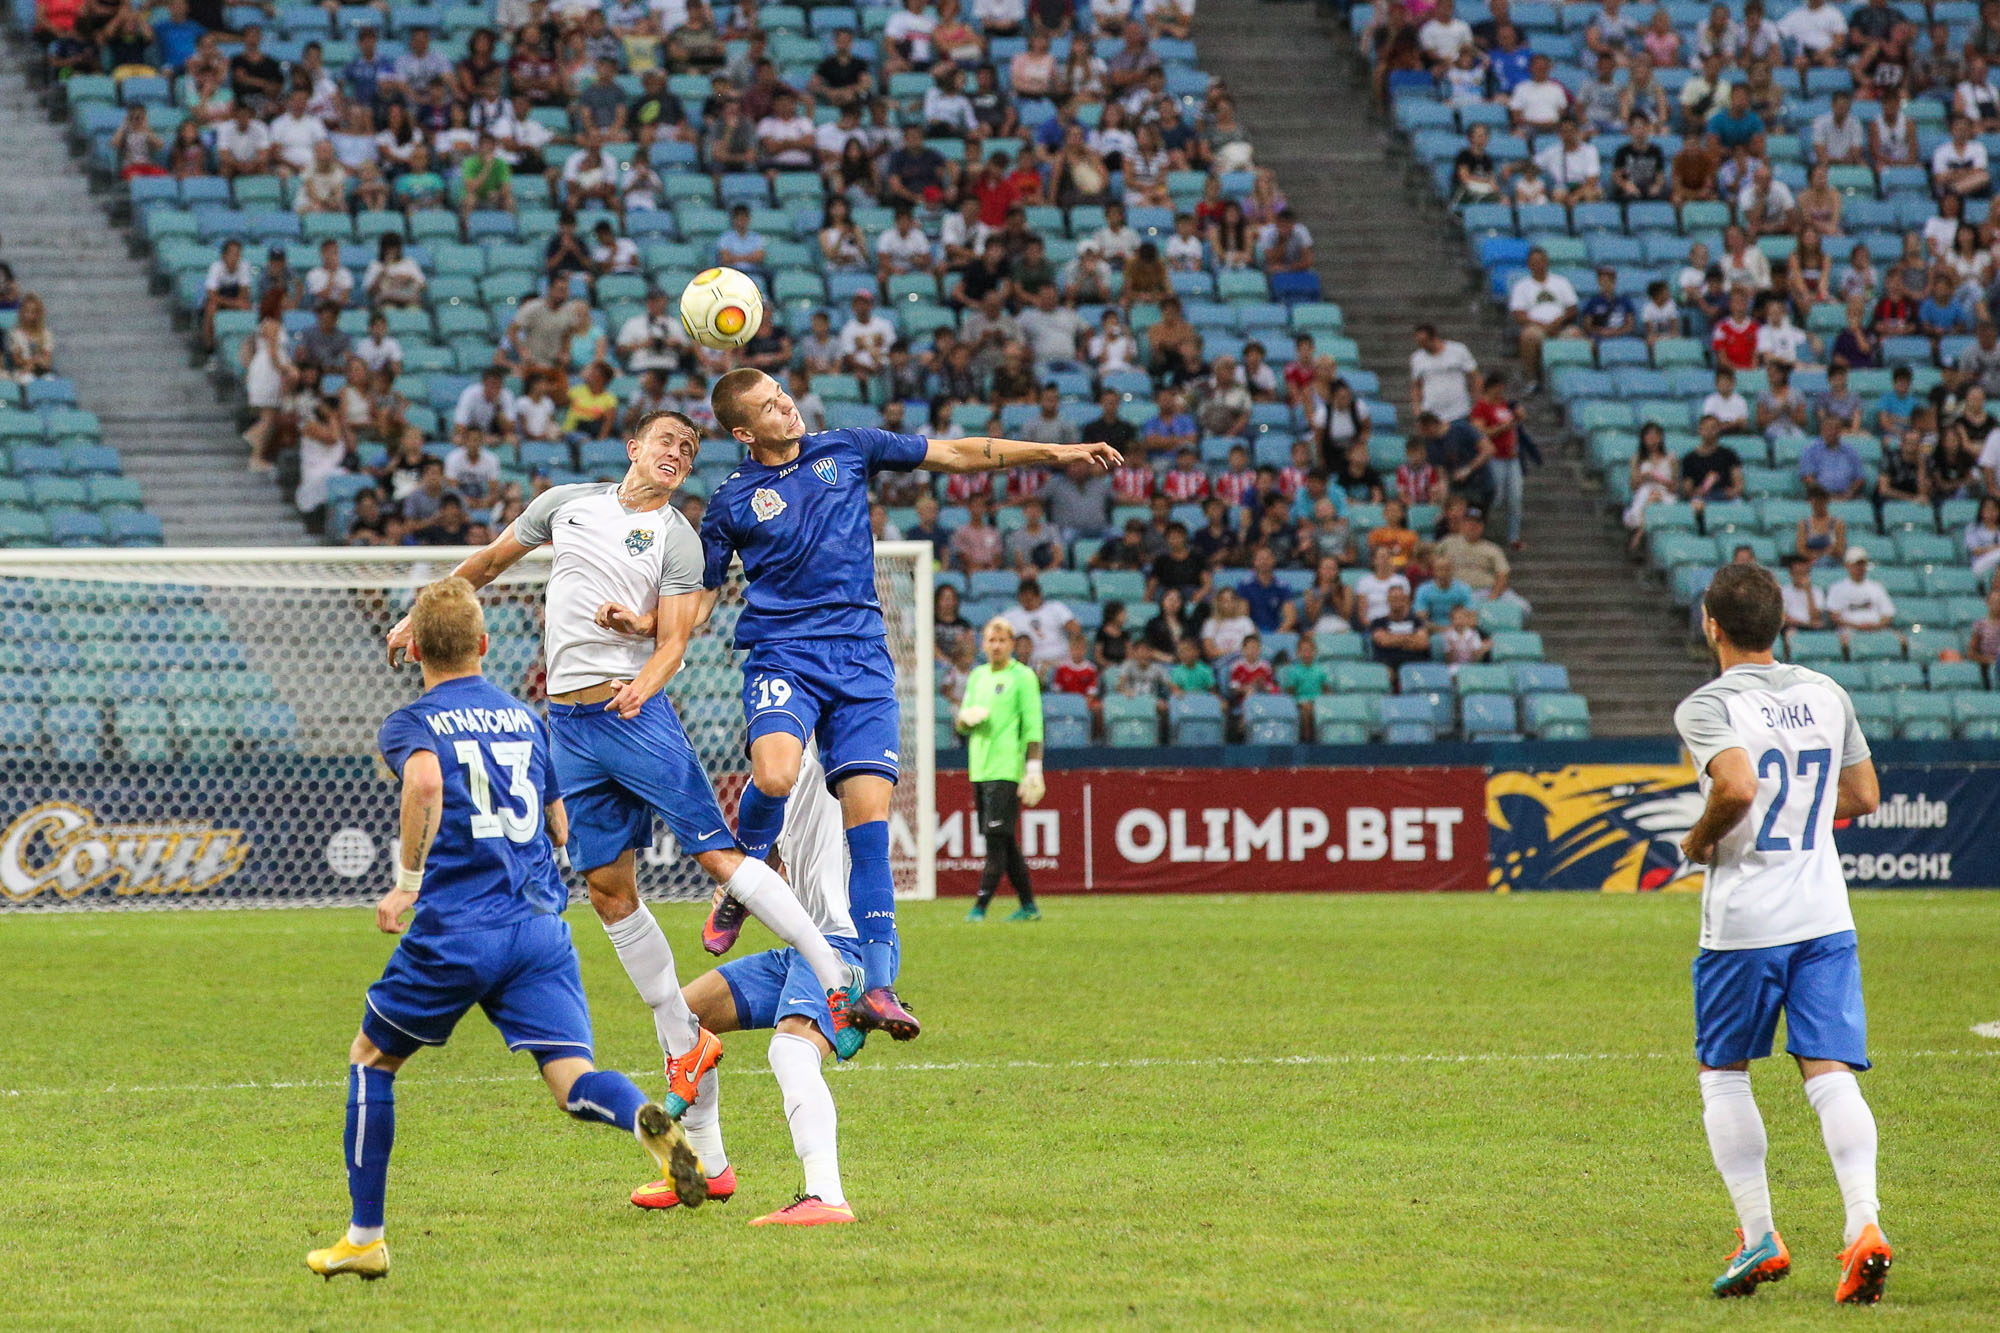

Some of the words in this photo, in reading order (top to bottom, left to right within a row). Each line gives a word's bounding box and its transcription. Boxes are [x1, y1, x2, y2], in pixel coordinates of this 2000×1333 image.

[755, 678, 792, 710] 19
[453, 740, 539, 843] 13
[1756, 748, 1831, 851] 27
[1115, 807, 1463, 863] OLIMP.BET
[865, 911, 895, 919] JAKO
